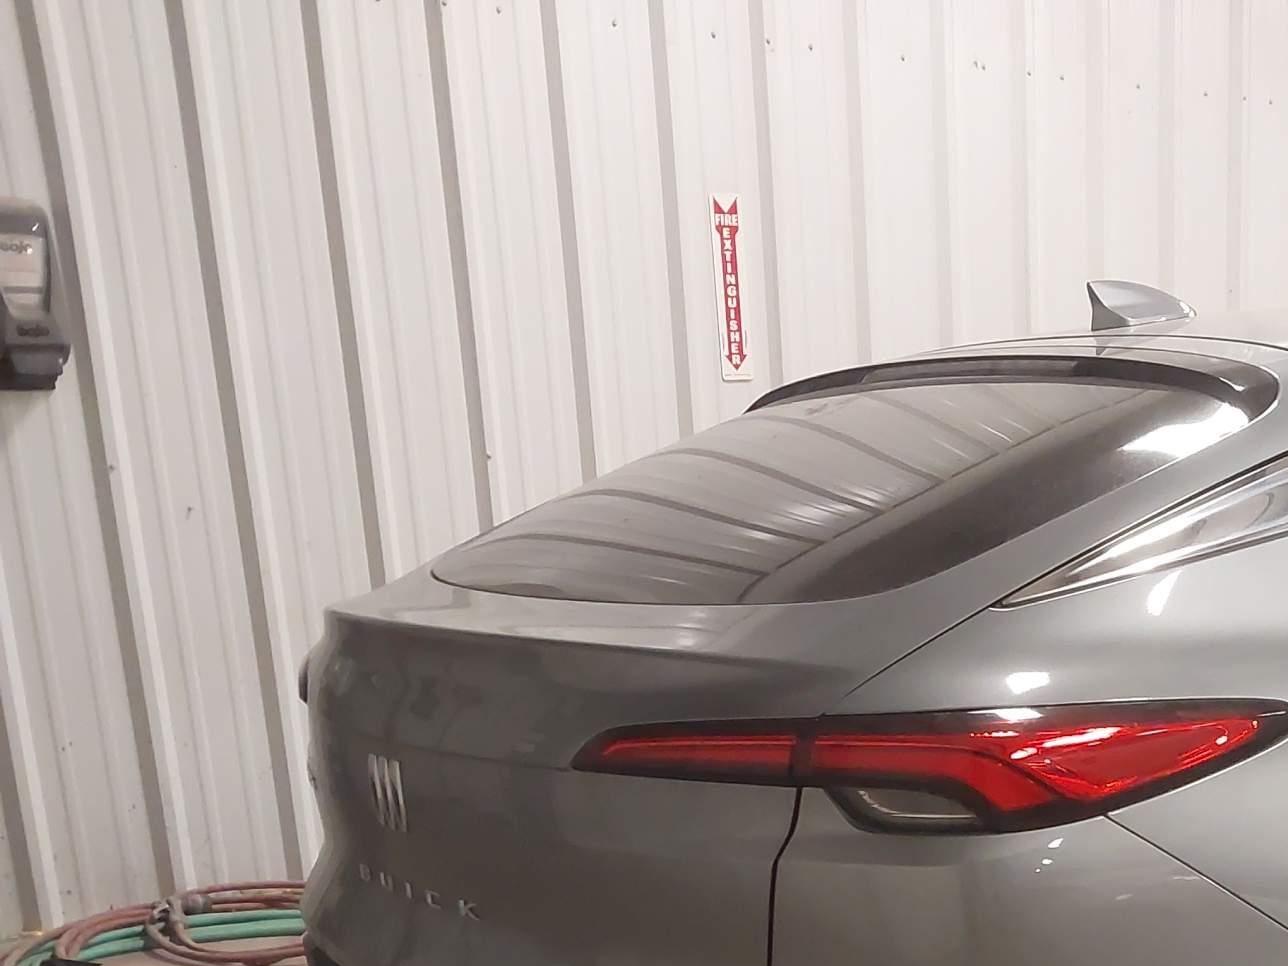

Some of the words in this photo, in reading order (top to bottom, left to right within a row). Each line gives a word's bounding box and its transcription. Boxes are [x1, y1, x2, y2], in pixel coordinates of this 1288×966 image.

[714, 213, 739, 226] FIRE
[722, 227, 742, 365] EXTINGUISHER
[359, 863, 481, 921] BUICK
